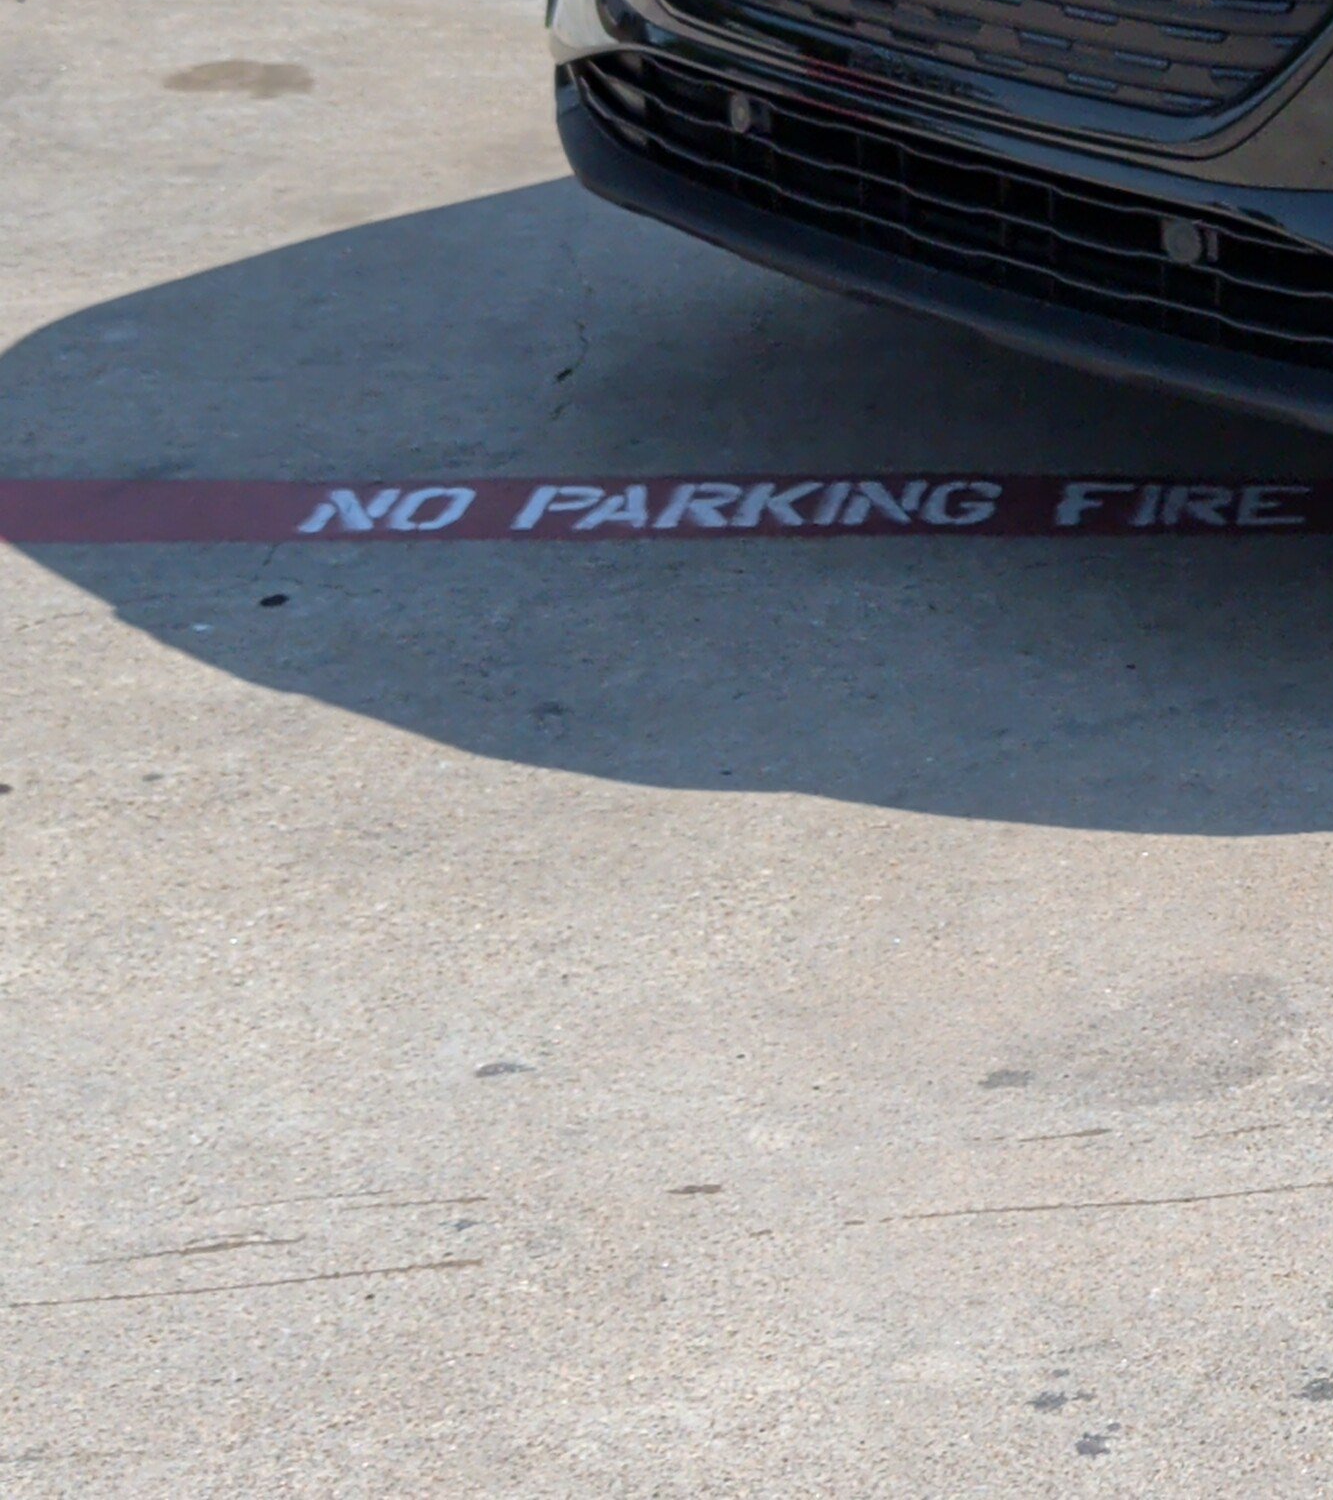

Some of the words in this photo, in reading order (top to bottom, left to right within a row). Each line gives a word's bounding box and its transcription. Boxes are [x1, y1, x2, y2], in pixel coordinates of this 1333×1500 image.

[298, 486, 477, 533] NO
[510, 480, 1003, 531] PARKING
[1055, 482, 1311, 527] FIRE
